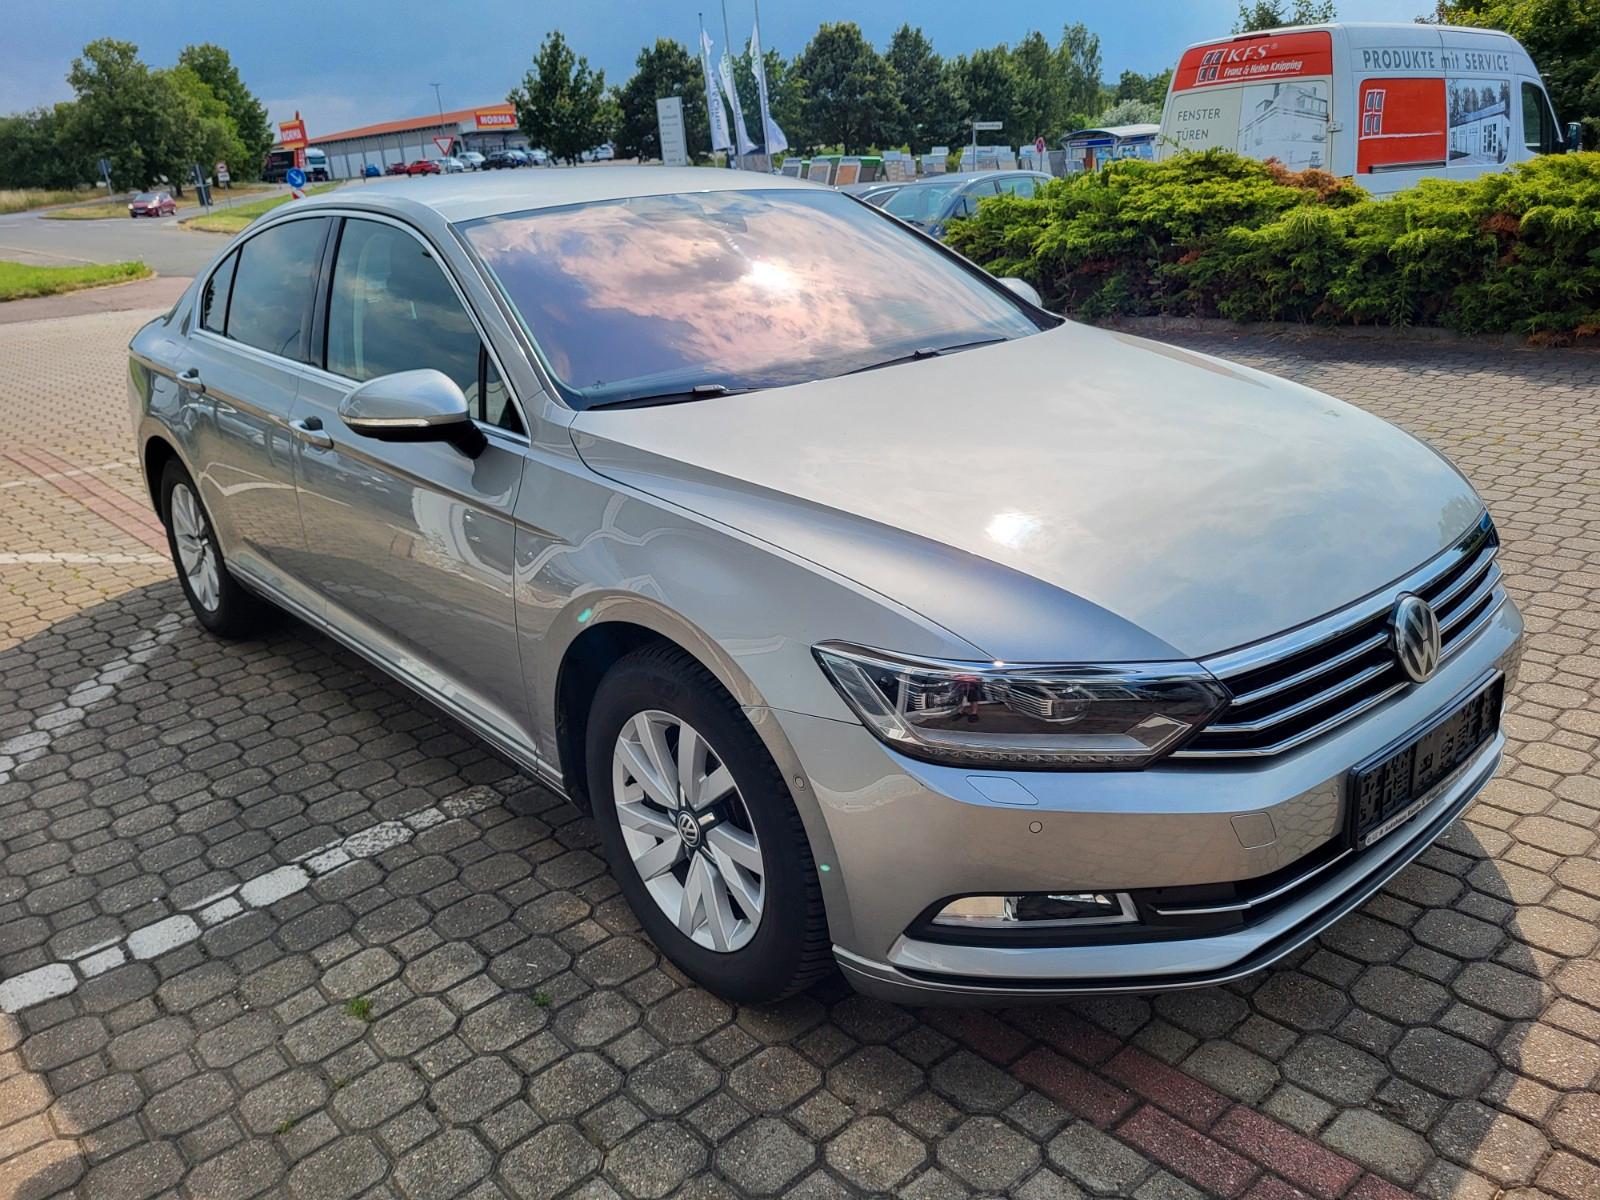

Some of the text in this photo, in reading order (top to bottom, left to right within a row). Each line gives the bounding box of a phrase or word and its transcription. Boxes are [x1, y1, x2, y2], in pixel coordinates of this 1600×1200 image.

[1362, 50, 1509, 71] PRODUKTE mit SERVICE
[1224, 67, 1242, 77] Franz
[1243, 64, 1250, 75] &
[1270, 59, 1303, 72] Knipping
[480, 114, 511, 125] NORMA
[1177, 108, 1221, 121] FENSTER
[282, 128, 302, 142] NORMA
[1176, 127, 1209, 142] TÜREN
